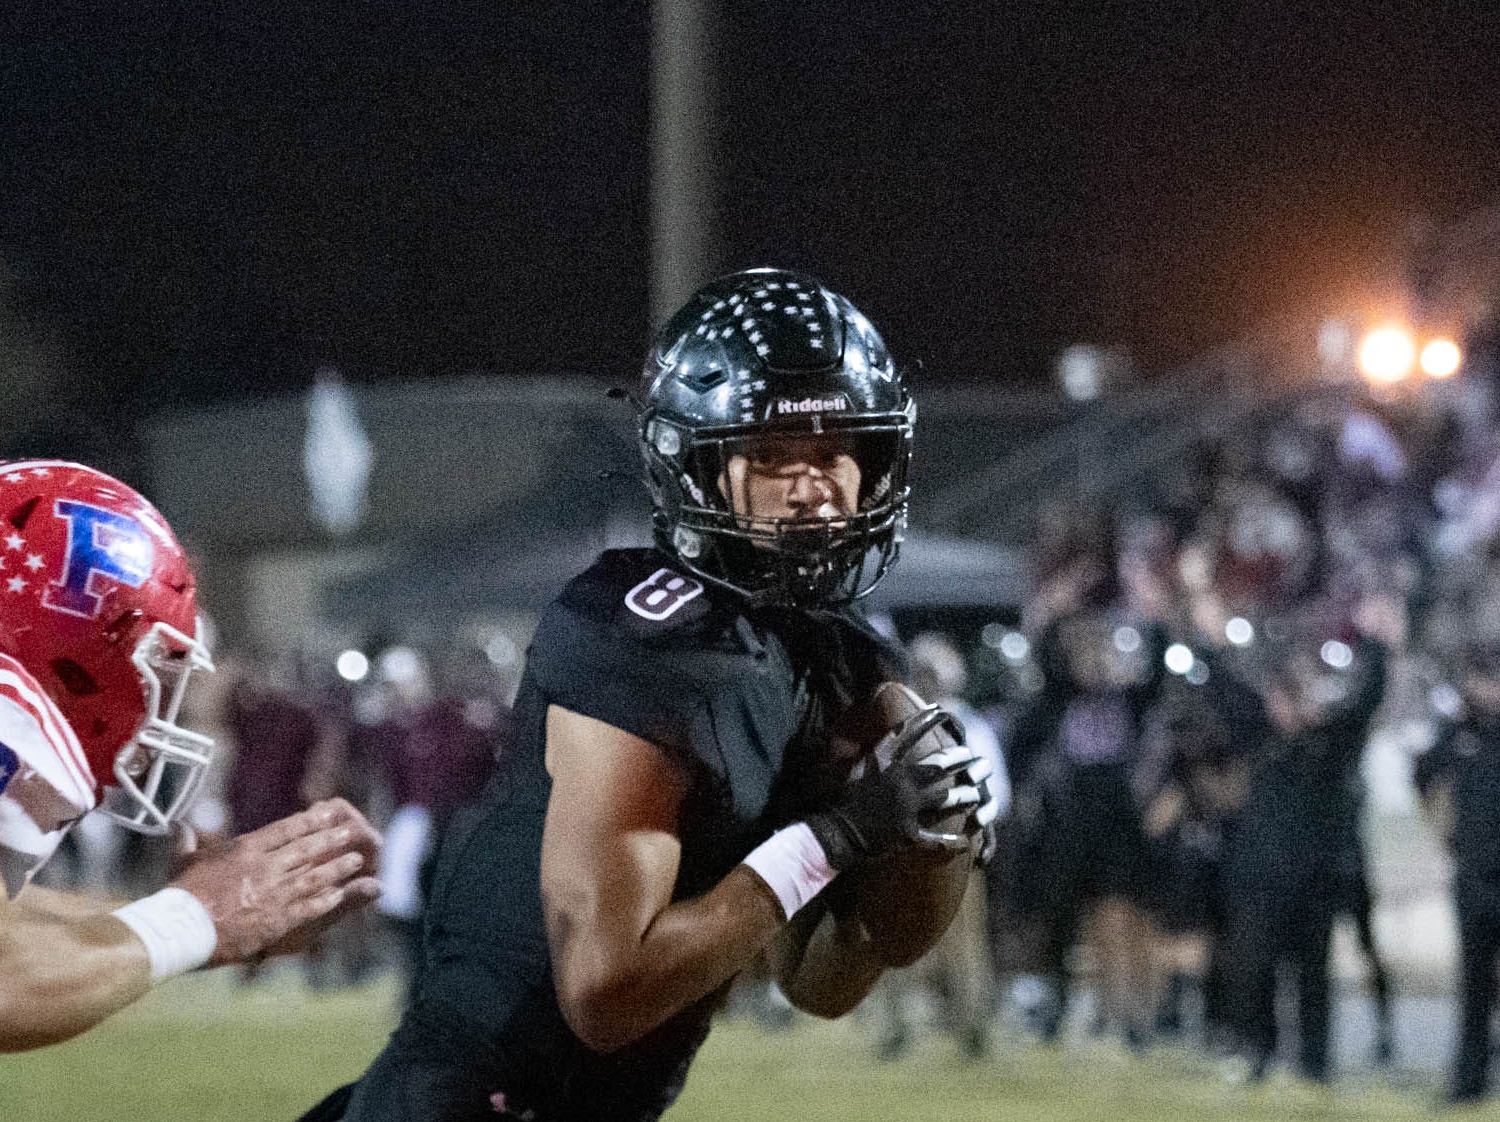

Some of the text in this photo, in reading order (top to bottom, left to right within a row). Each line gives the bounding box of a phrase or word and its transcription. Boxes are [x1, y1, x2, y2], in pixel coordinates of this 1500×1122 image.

[777, 398, 846, 414] Riddell
[41, 499, 156, 621] P
[623, 567, 705, 621] 8
